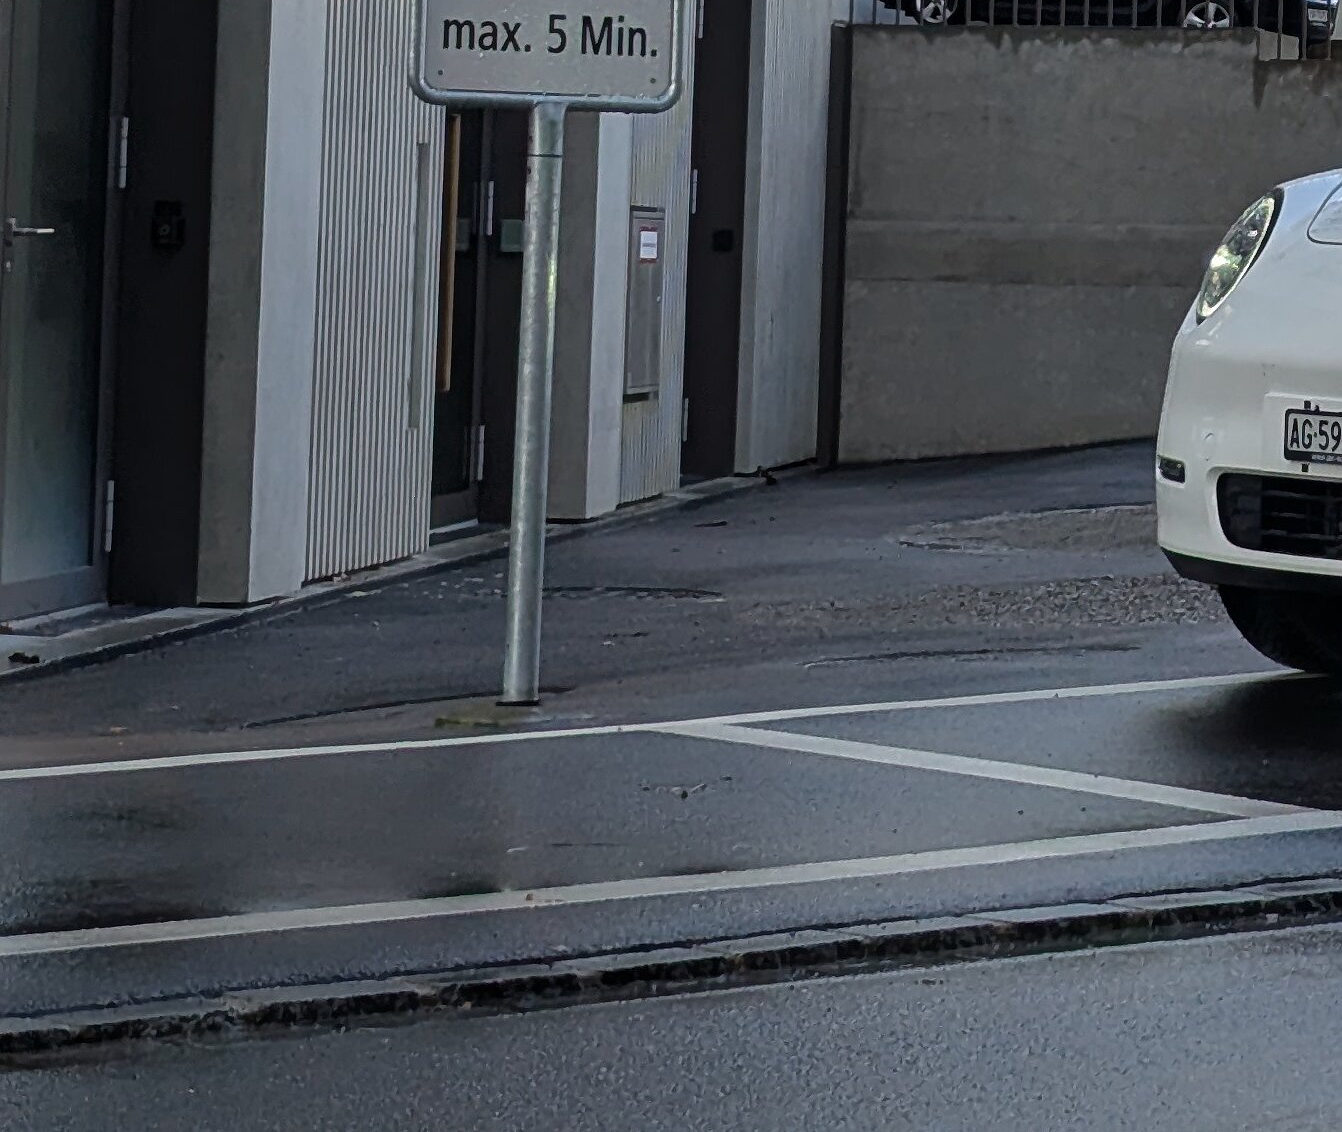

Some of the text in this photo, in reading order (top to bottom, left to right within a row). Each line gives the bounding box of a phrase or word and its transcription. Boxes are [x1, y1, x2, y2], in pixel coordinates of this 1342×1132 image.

[442, 15, 658, 58] max. 5 Min.
